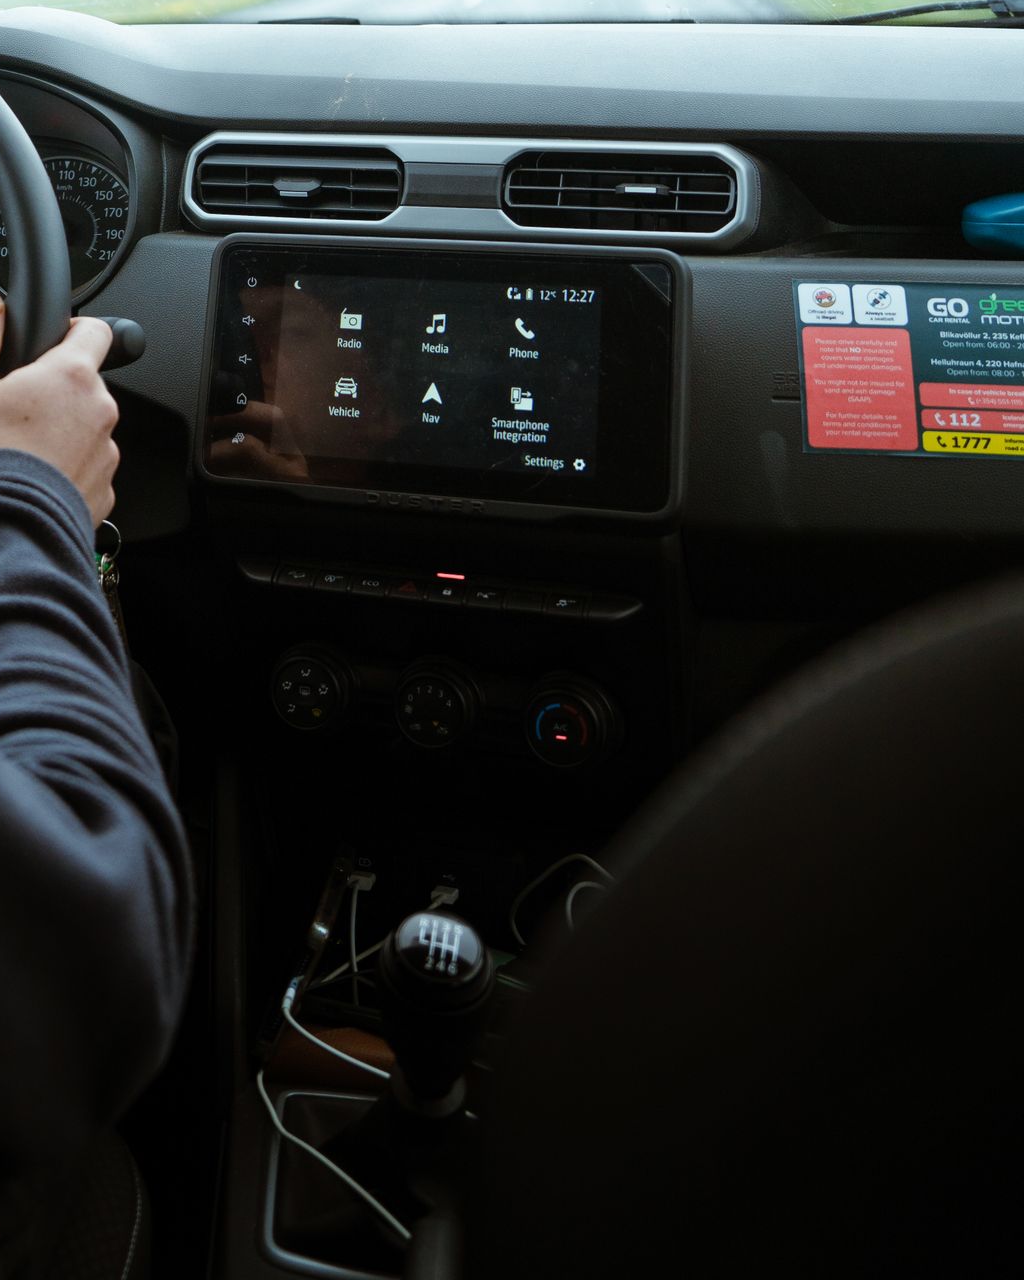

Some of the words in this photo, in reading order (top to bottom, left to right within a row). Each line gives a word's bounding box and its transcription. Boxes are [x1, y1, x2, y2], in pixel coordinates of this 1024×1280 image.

[58, 169, 76, 181] 110
[78, 176, 97, 188] 130
[94, 190, 114, 201] 150
[104, 207, 123, 218] 170
[106, 228, 125, 240] 190
[562, 289, 595, 303] 12:27
[927, 297, 969, 318] GO
[939, 331, 981, 339] Blikavöllur
[992, 332, 1008, 340] 235
[337, 337, 362, 349] Radio
[421, 342, 449, 354] Media
[942, 340, 965, 348] Open
[509, 347, 539, 359] Phone
[930, 358, 974, 367] Helluhraun
[946, 368, 968, 376] Open
[328, 405, 360, 418] Vehicle
[422, 412, 440, 423] Nav
[491, 417, 550, 431] Smartphone
[950, 412, 981, 427] 112
[493, 429, 547, 443] Integration
[952, 436, 991, 449] 1777
[524, 455, 564, 470] Settings
